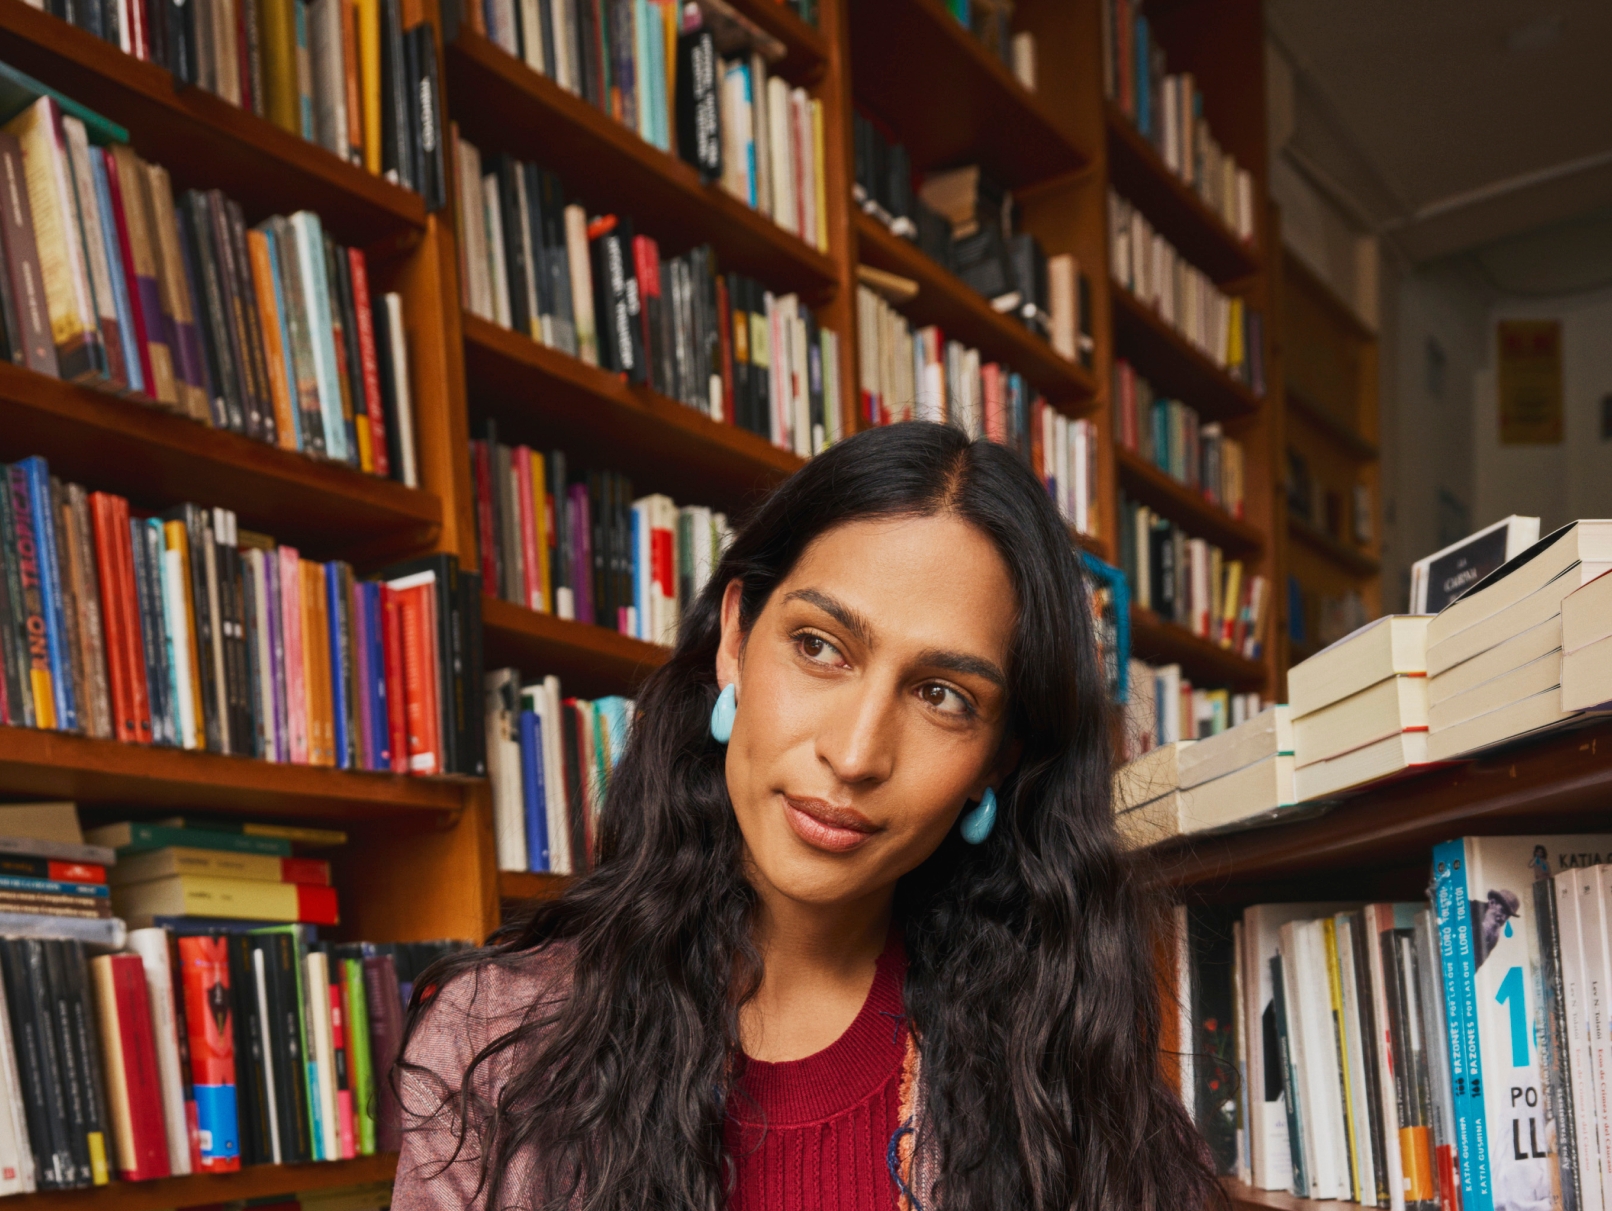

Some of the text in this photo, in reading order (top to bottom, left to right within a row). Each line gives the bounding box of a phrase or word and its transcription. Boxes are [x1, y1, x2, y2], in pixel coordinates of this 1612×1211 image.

[12, 470, 39, 588] TROPICAL
[1559, 853, 1601, 869] KATIA
[1454, 887, 1466, 921] TOLSTÓI
[1458, 929, 1469, 956] LLORÓ
[1463, 962, 1471, 978] QUE
[1464, 981, 1472, 995] LAS
[1593, 998, 1600, 1008] N.
[1466, 1000, 1474, 1017] POR
[1495, 966, 1537, 1067] 1
[1571, 999, 1576, 1008] N.
[1594, 1010, 1603, 1039] Tolstói
[1451, 1022, 1463, 1074] RAZONES
[1466, 1022, 1479, 1075] RAZONES
[1577, 1069, 1583, 1078] de
[1600, 1069, 1607, 1078] de
[1578, 1081, 1586, 1112] Crimea
[1600, 1081, 1610, 1111] Crimea
[1475, 1119, 1487, 1159] GUSHINA
[1583, 1136, 1591, 1170] Cáucaso
[1464, 1160, 1474, 1192] KATIA
[1480, 1163, 1490, 1194] KATIA
